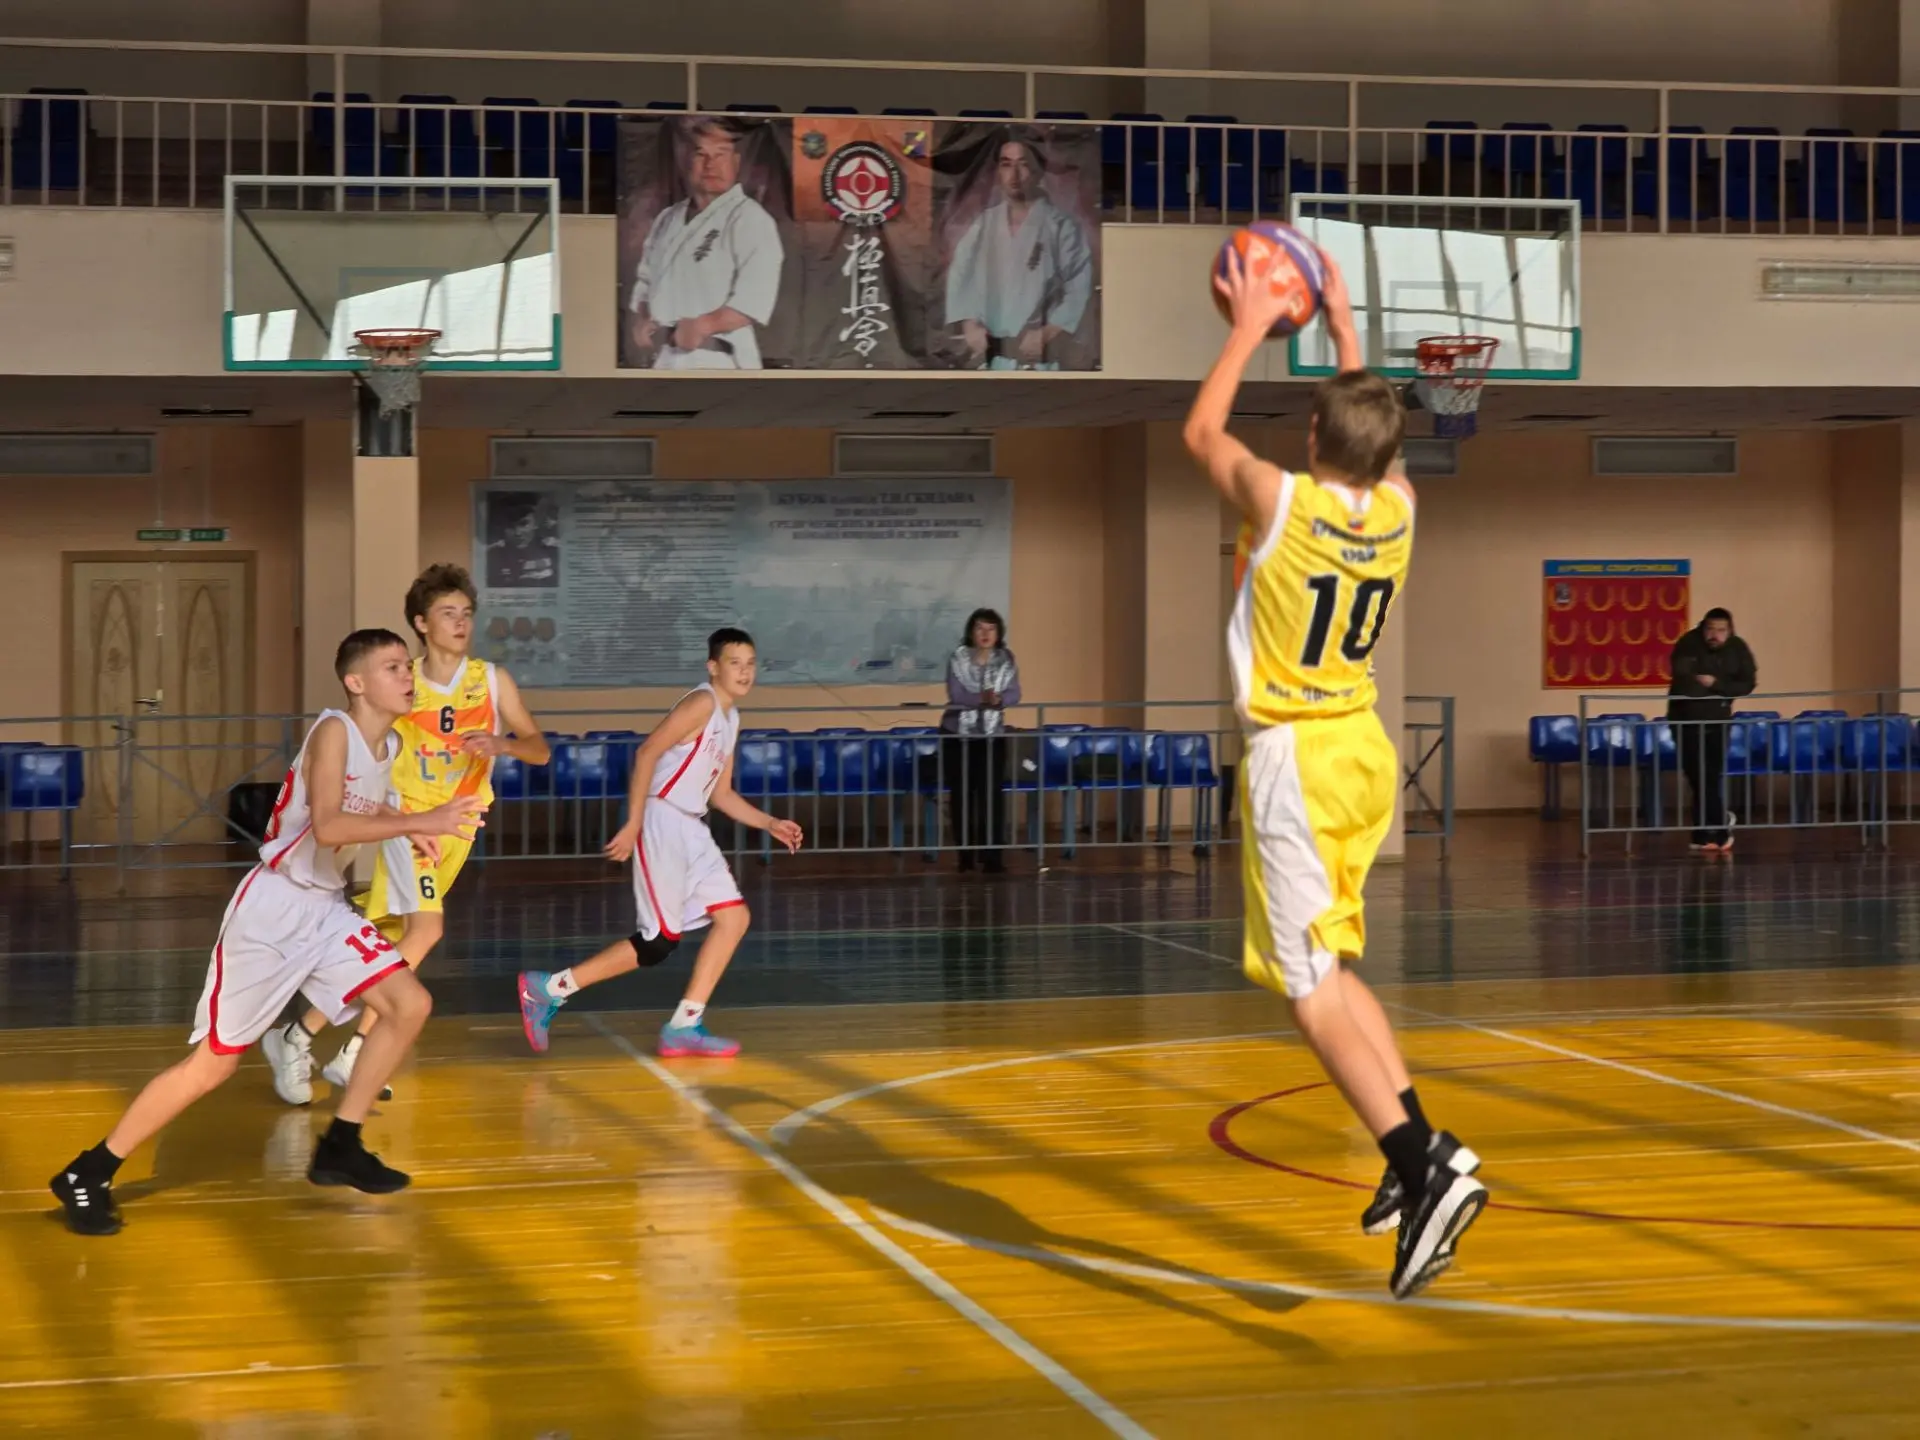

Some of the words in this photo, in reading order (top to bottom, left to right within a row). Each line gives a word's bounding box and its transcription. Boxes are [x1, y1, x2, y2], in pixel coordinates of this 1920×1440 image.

[1301, 574, 1394, 668] 10
[440, 705, 456, 733] 6
[419, 875, 435, 900] 6
[345, 925, 394, 964] 13
